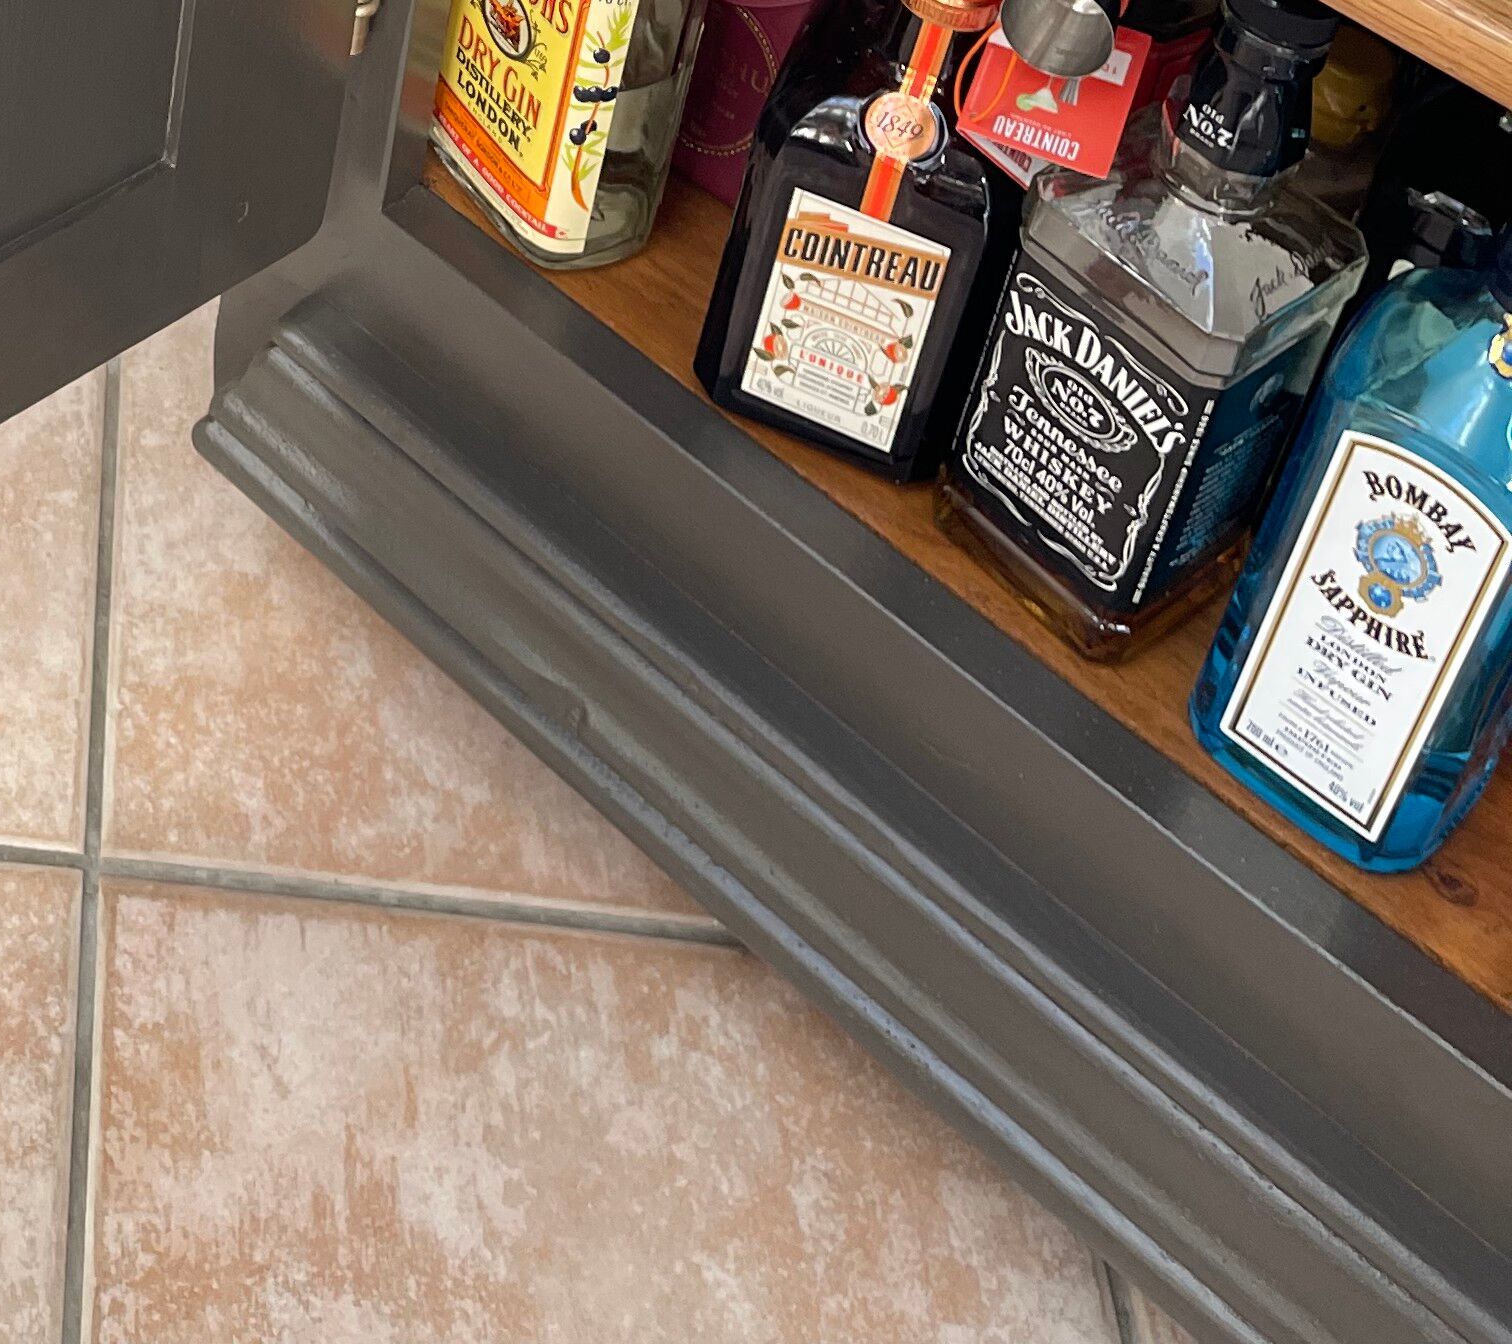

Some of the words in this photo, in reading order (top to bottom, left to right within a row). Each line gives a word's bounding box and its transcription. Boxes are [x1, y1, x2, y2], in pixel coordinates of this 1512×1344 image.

[458, 14, 502, 82] DRY
[504, 65, 542, 130] GIN
[875, 111, 924, 139] 1849
[991, 113, 1081, 162] COINTREAU
[784, 227, 941, 292] COINTREAU
[1005, 290, 1075, 358] JACK
[1074, 329, 1186, 454] DANIEL'S
[1004, 415, 1113, 514] WHISKEY
[1008, 385, 1123, 494] Tennessee
[974, 441, 1003, 470] JACK
[1047, 503, 1118, 566] DISTILLERY
[1004, 438, 1036, 476] 70cl
[1035, 470, 1068, 505] 40%
[1071, 494, 1096, 529] Vol.
[1362, 469, 1478, 555] BOMBAY
[1310, 568, 1430, 661] SAPPHIRE
[1296, 666, 1377, 726] INFUSED
[1304, 636, 1348, 670] DRY
[1351, 668, 1393, 702] GIN
[1320, 634, 1388, 685] LONDON
[1328, 780, 1349, 804] 40%
